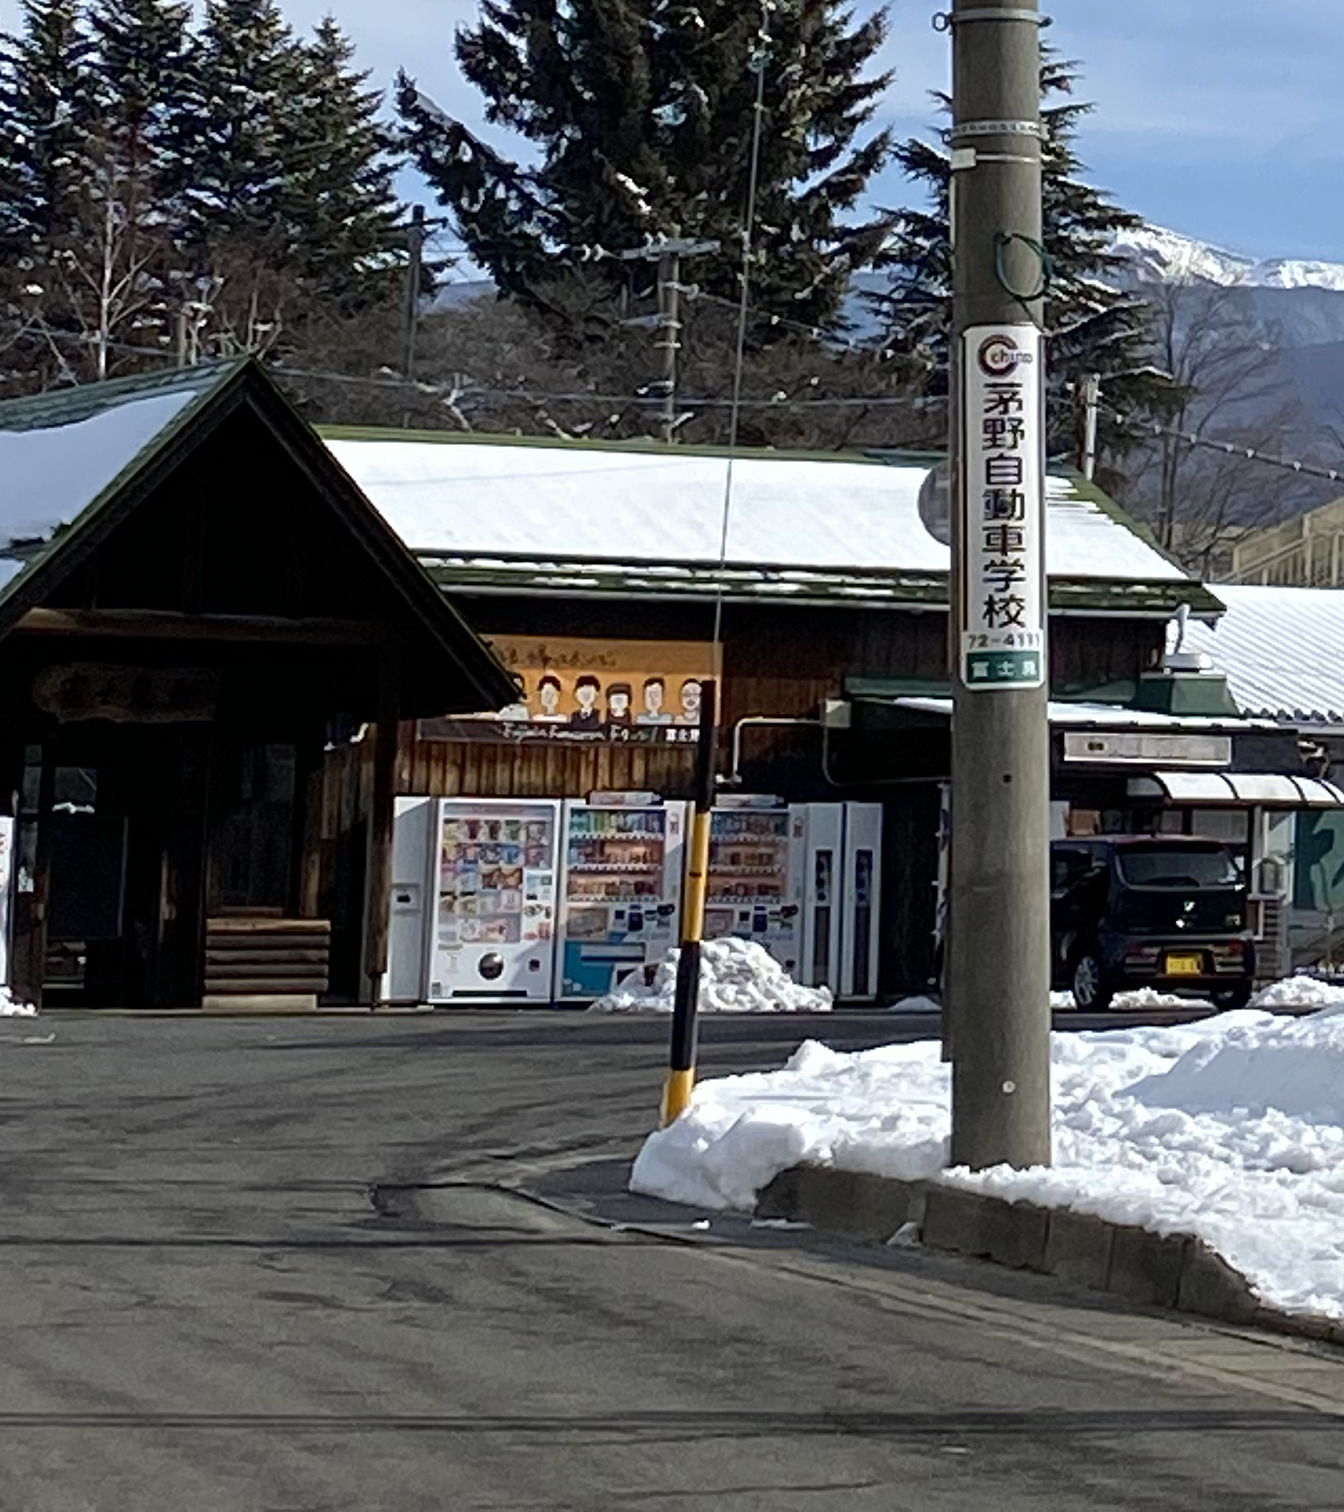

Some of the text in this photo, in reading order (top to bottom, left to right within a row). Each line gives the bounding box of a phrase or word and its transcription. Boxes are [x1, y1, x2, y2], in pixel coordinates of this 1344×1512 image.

[981, 382, 1026, 630] 茅野自動車学校
[967, 633, 1040, 649] 72-4111
